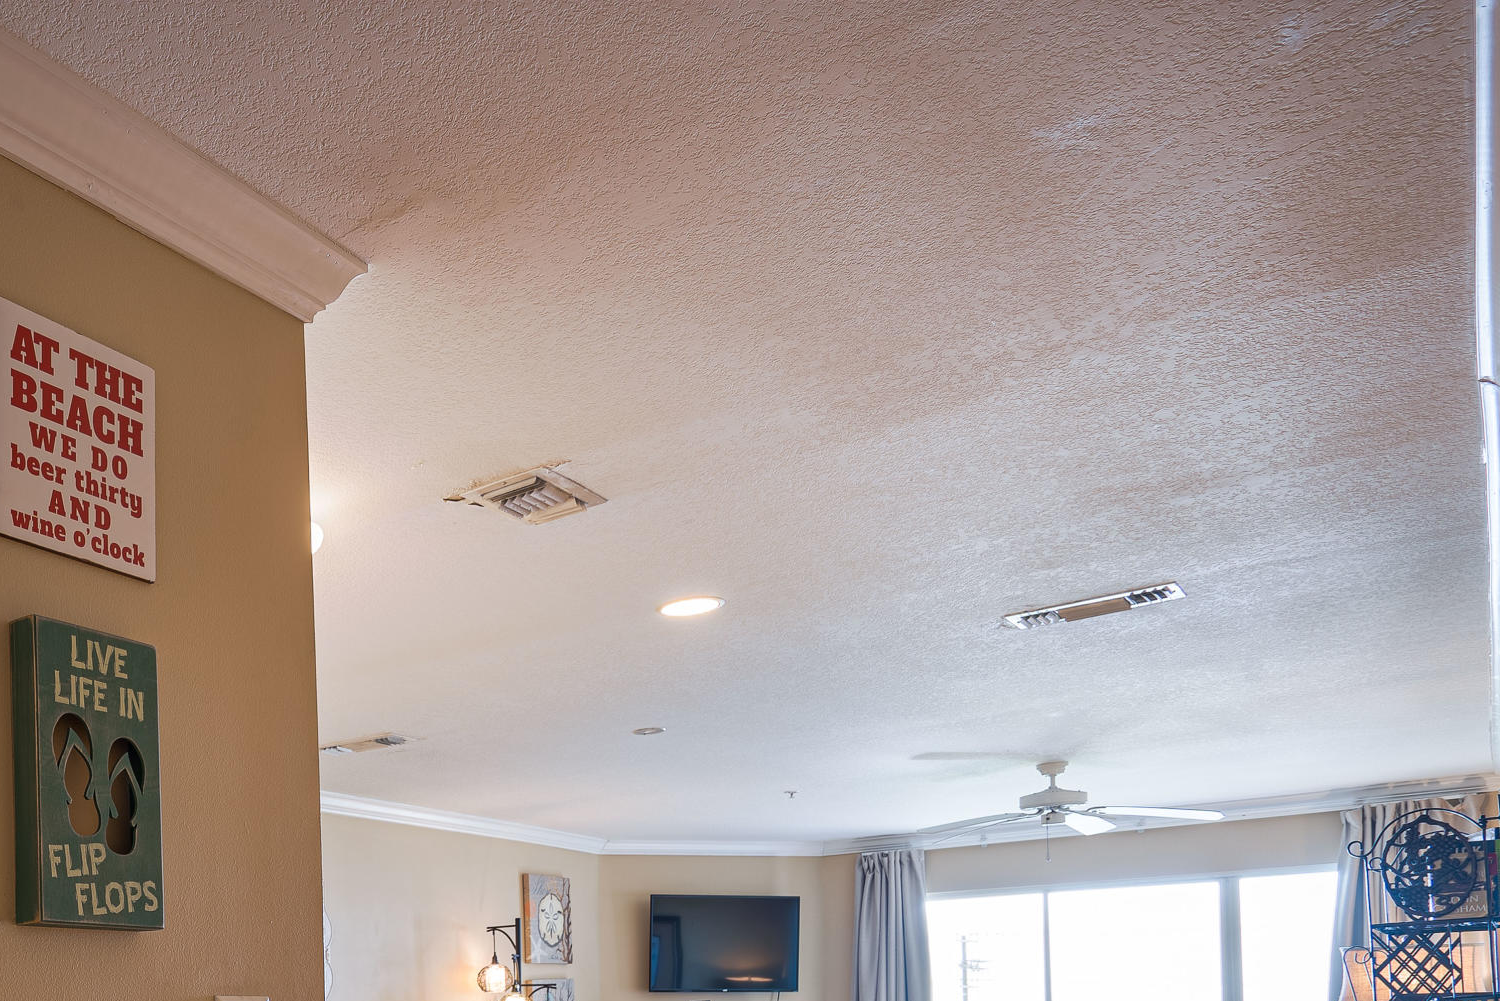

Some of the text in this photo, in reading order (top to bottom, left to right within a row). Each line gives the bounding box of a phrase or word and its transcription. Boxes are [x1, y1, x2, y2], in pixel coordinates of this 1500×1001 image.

[10, 324, 143, 414] AT THE
[10, 368, 144, 457] BEACH
[28, 421, 127, 480] WE DO
[10, 443, 142, 519] beer thirty
[48, 489, 111, 531] AND
[10, 509, 145, 567] wine o'clock
[70, 634, 128, 679] LIVE
[54, 669, 144, 722] LIFE IN
[48, 842, 107, 878] FLIP
[75, 880, 159, 917] FLOPS
